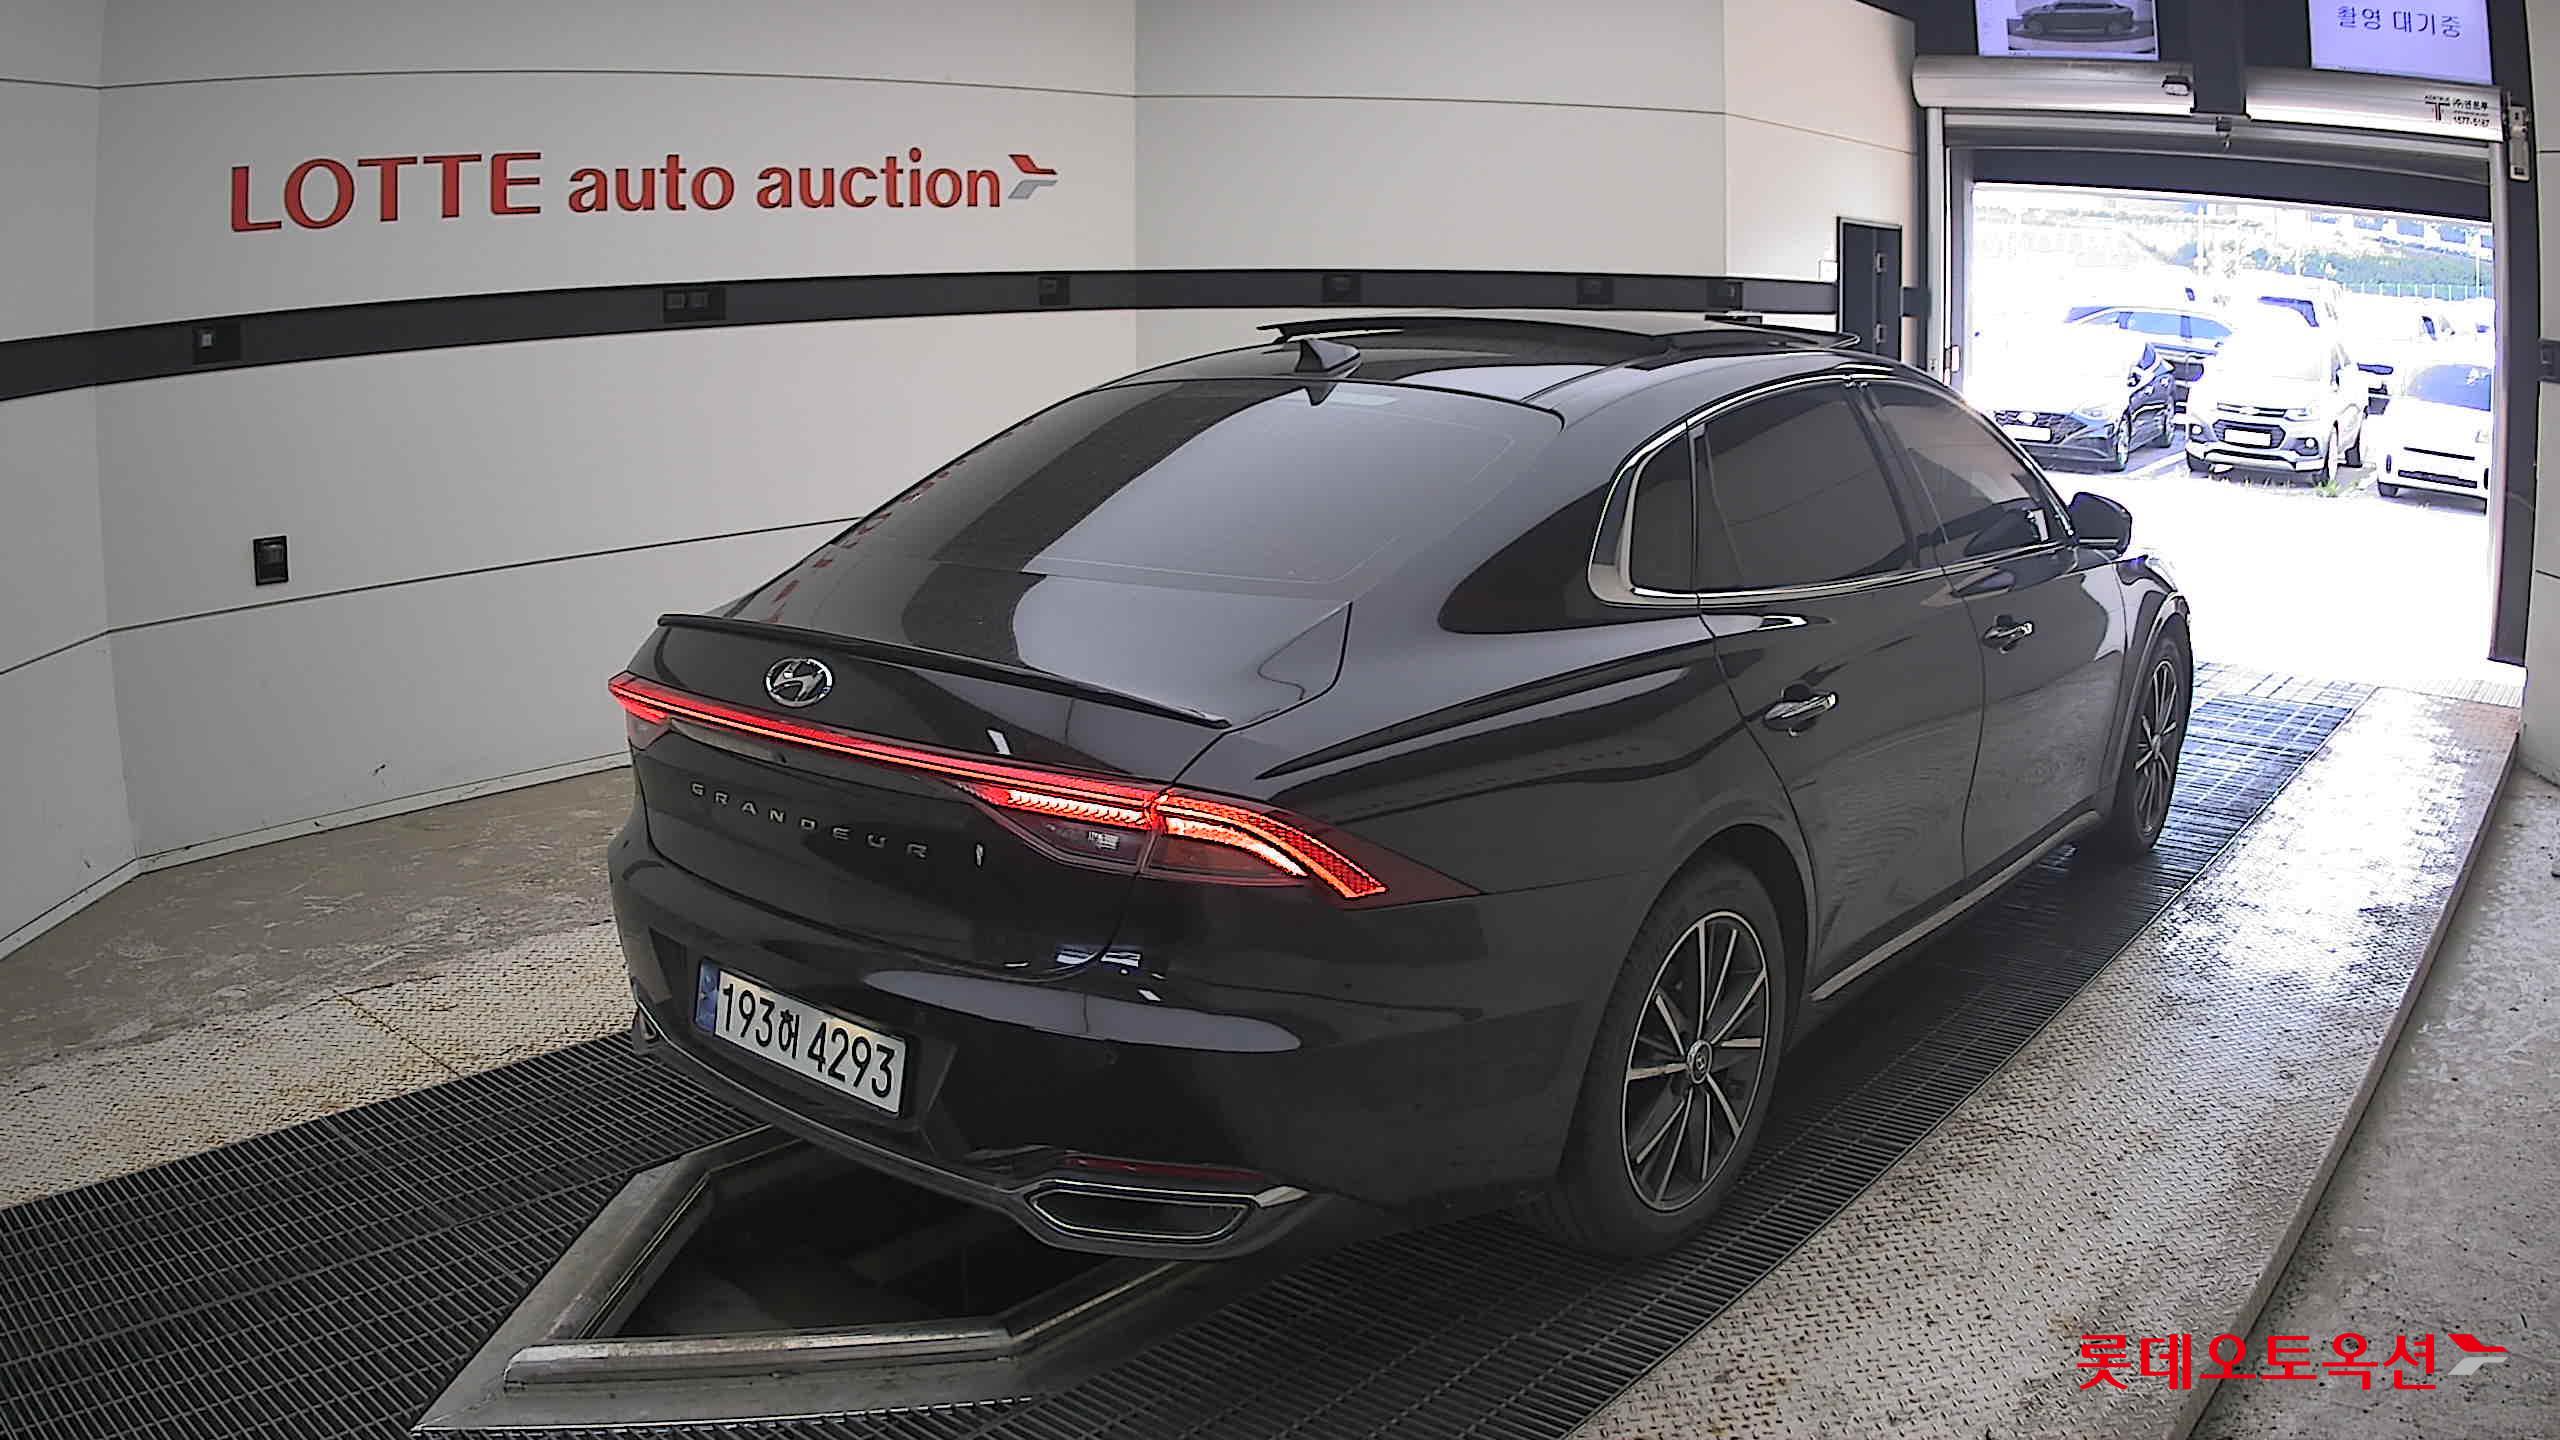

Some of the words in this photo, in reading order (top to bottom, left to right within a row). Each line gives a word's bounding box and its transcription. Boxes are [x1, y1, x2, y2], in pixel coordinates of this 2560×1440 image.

[2337, 5, 2382, 31] 촬영
[2392, 10, 2462, 39] 대기중
[230, 151, 542, 233] LOTTE
[568, 154, 735, 214] auto
[756, 147, 1001, 209] auction
[690, 782, 928, 859] GRANDEUR
[722, 983, 800, 1060] 193허
[807, 1021, 896, 1098] 4293
